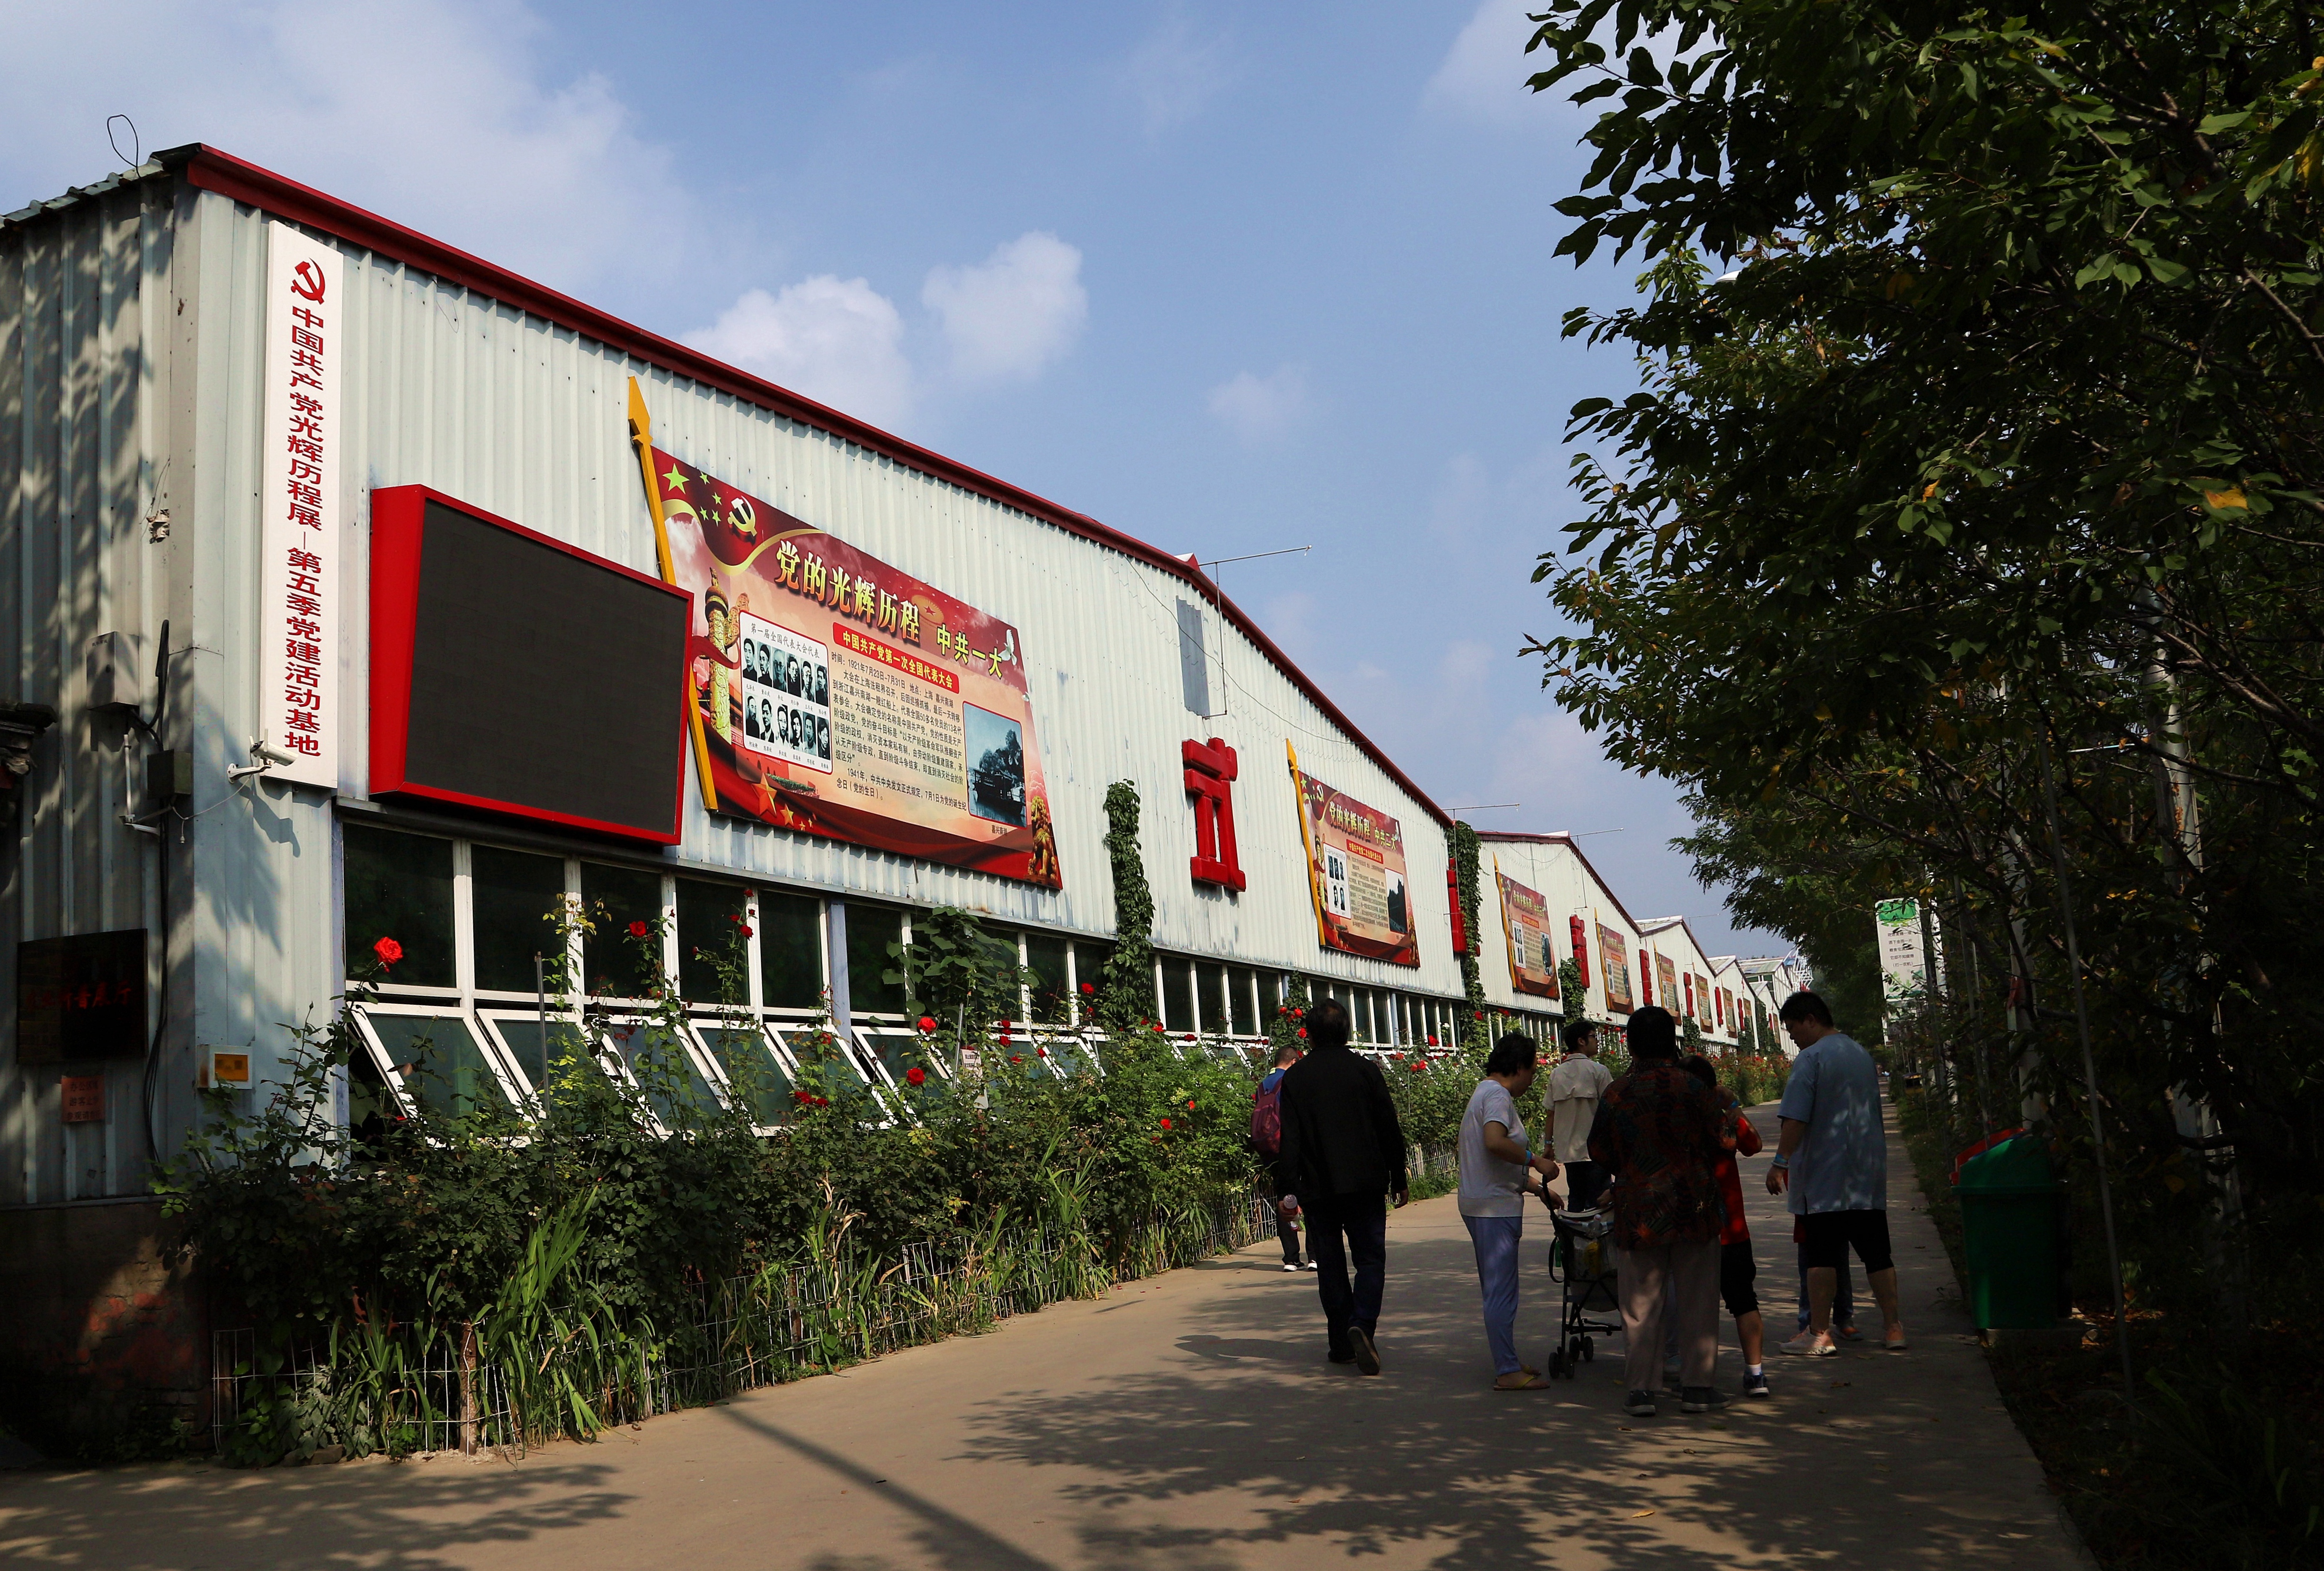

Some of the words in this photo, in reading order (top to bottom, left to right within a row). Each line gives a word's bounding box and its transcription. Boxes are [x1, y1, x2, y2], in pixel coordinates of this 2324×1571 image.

[775, 540, 919, 643] 党的光辉历程
[936, 624, 1002, 678] 中共一大
[751, 623, 820, 659] 第一届全国代表大会代表
[843, 631, 953, 689] 中国共产党第一次全国代表大会
[1329, 801, 1371, 840] 党的光辉历程
[1375, 827, 1397, 850] 中共二大
